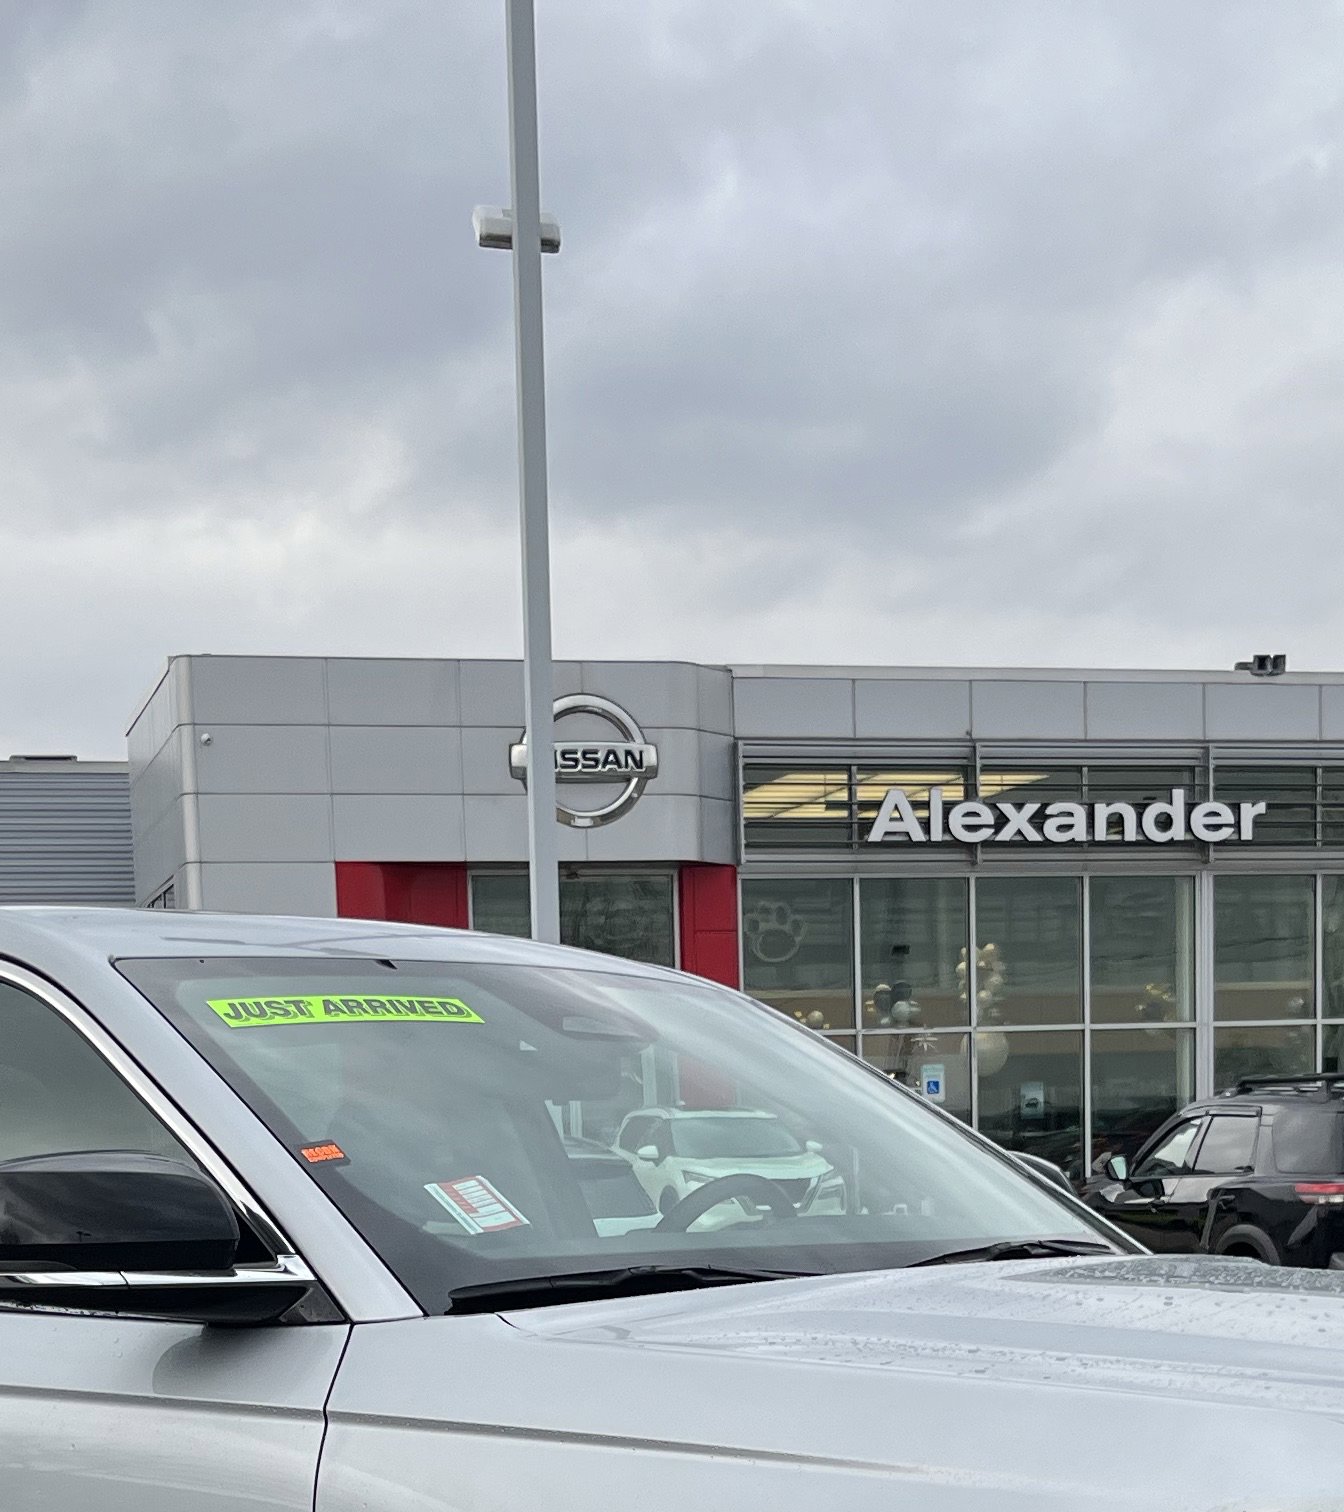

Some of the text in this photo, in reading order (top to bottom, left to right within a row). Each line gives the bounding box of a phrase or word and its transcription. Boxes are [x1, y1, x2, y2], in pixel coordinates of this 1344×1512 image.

[866, 787, 1267, 843] Alexander
[223, 999, 472, 1021] JUST ARRIVED
